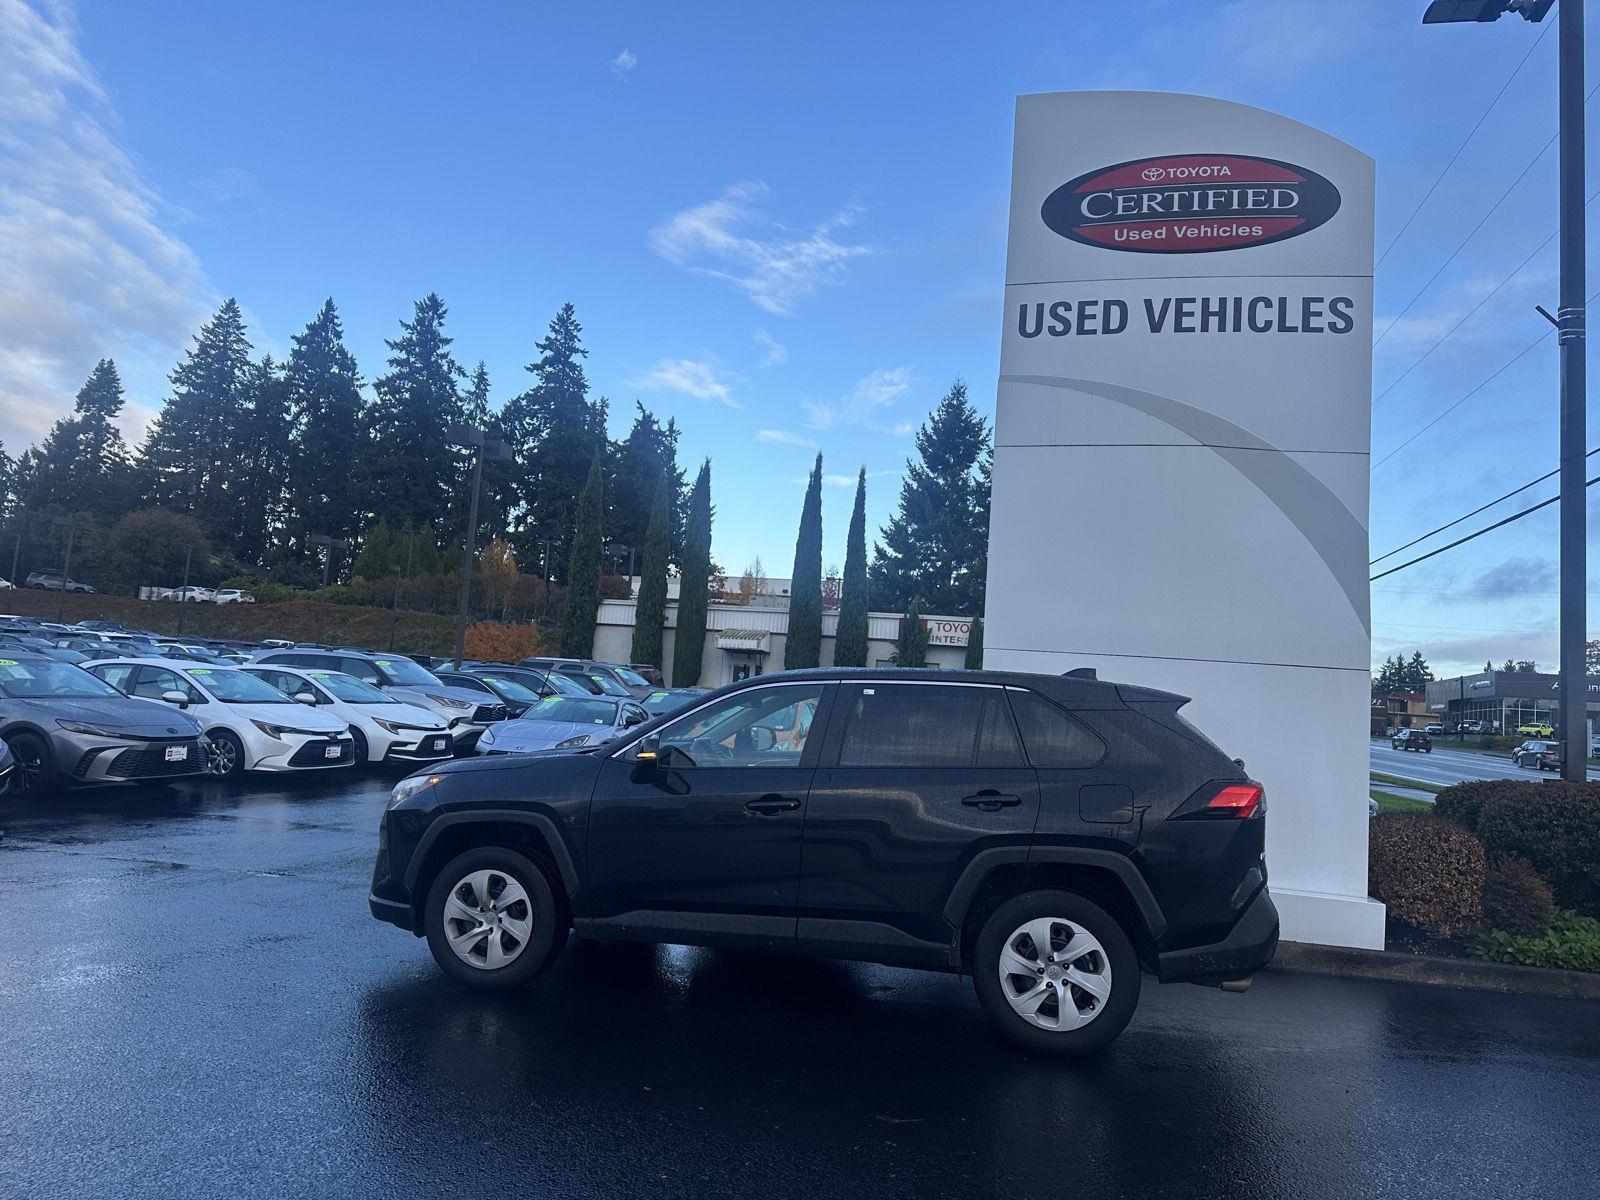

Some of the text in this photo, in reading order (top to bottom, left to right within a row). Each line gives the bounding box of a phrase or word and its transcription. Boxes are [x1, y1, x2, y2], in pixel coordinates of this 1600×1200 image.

[1167, 166, 1231, 179] TOYOTA
[1080, 188, 1299, 219] CERTIFIED
[1114, 224, 1263, 242] Used Vehicles
[1018, 296, 1354, 338] USED VEHICLES
[935, 622, 971, 633] TOYO
